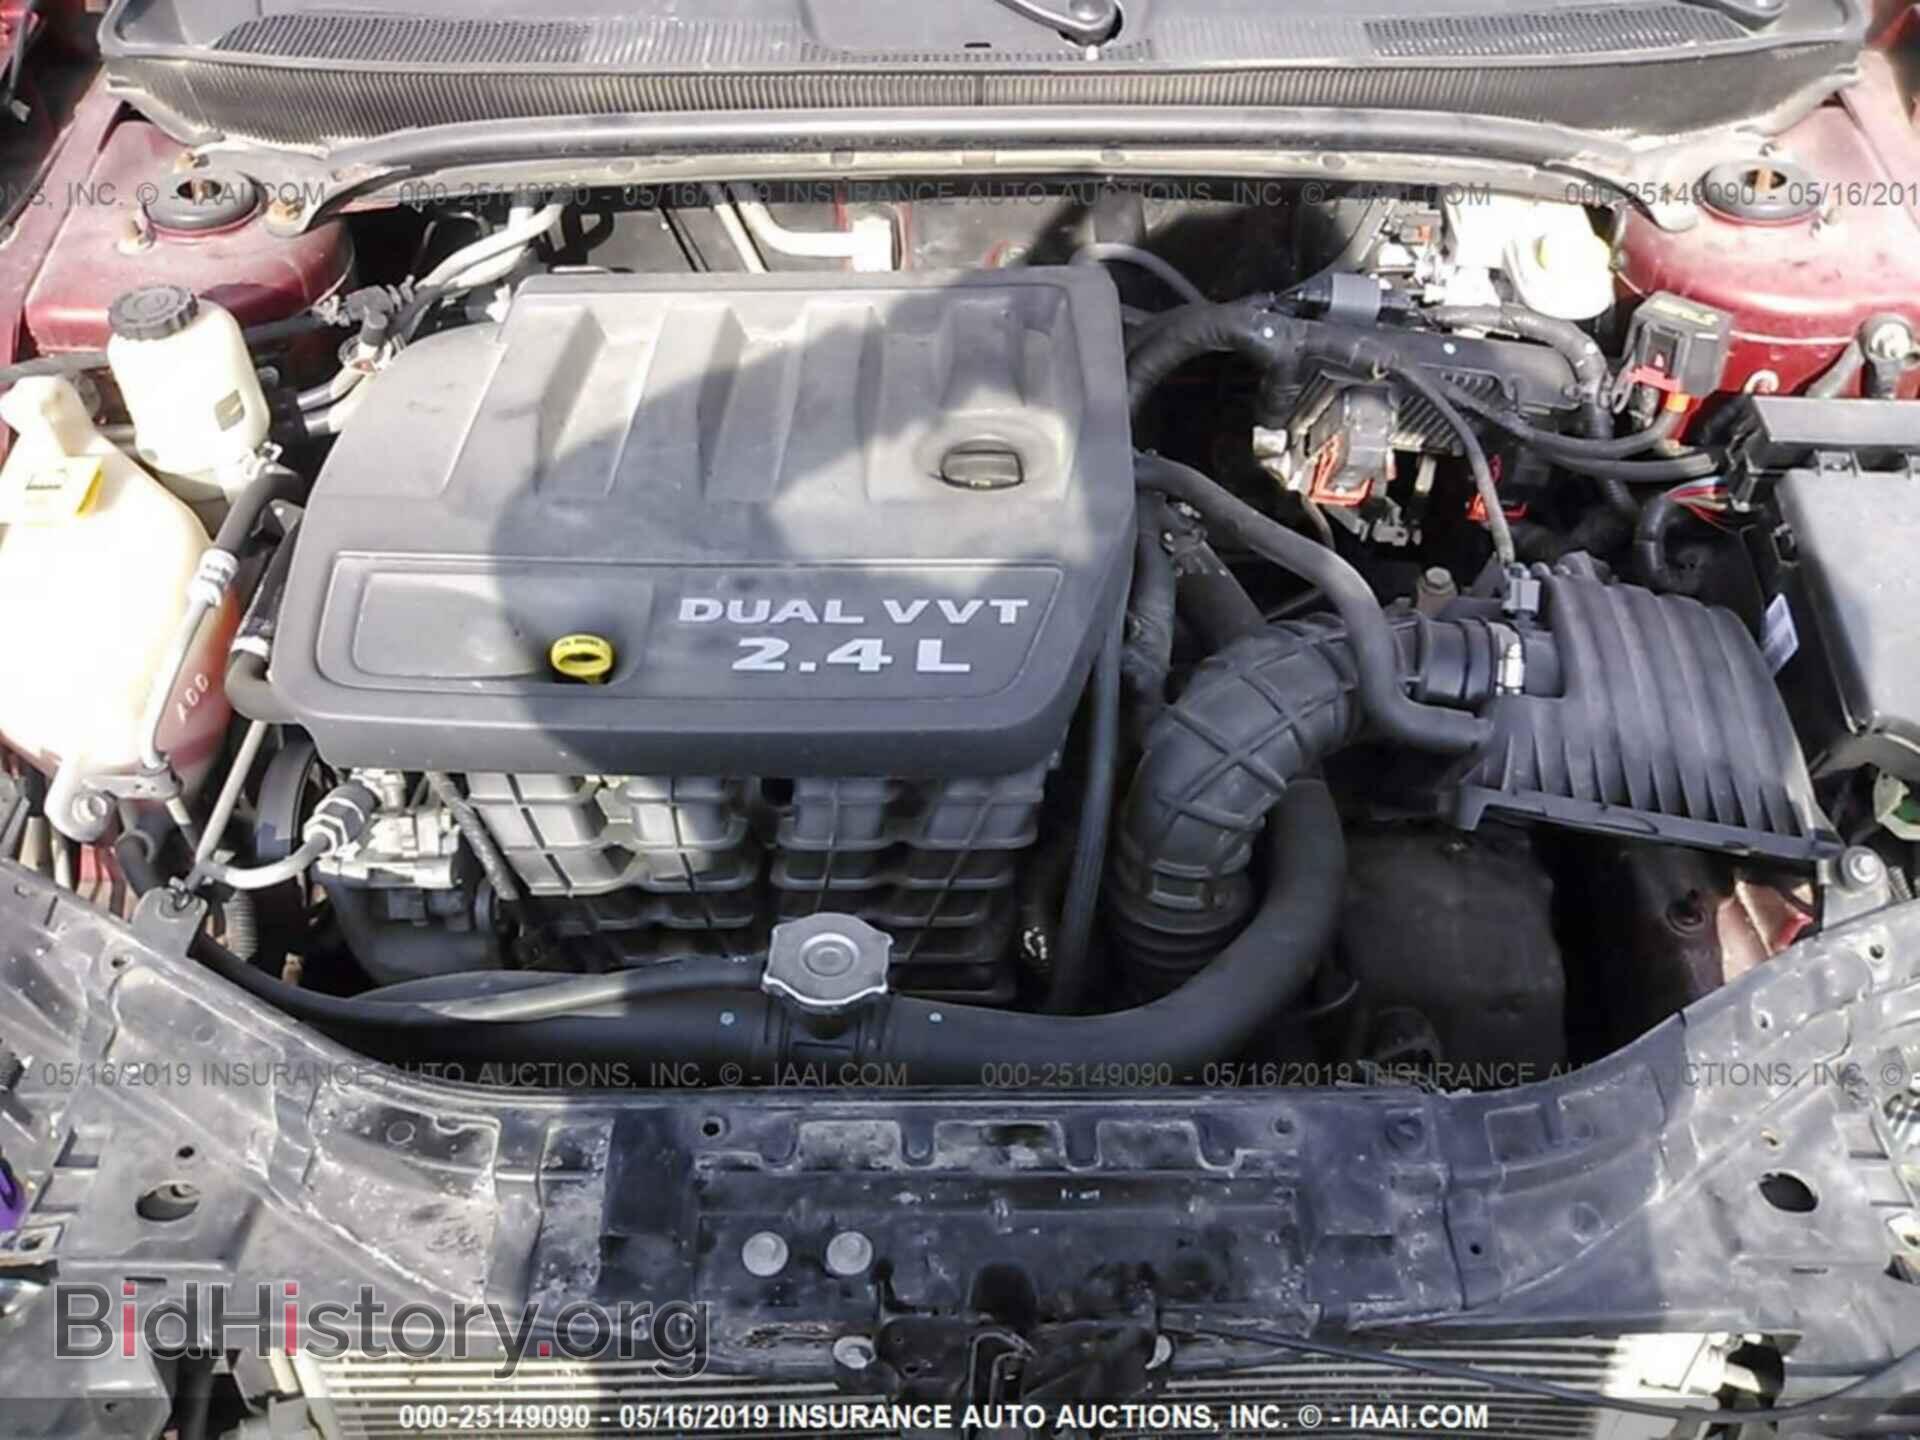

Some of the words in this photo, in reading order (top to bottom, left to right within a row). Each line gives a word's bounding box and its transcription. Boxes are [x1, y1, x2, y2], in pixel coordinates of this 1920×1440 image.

[678, 598, 865, 624] DUAL
[882, 599, 1030, 624] VVT
[732, 637, 893, 673] 2.4
[915, 639, 972, 673] L
